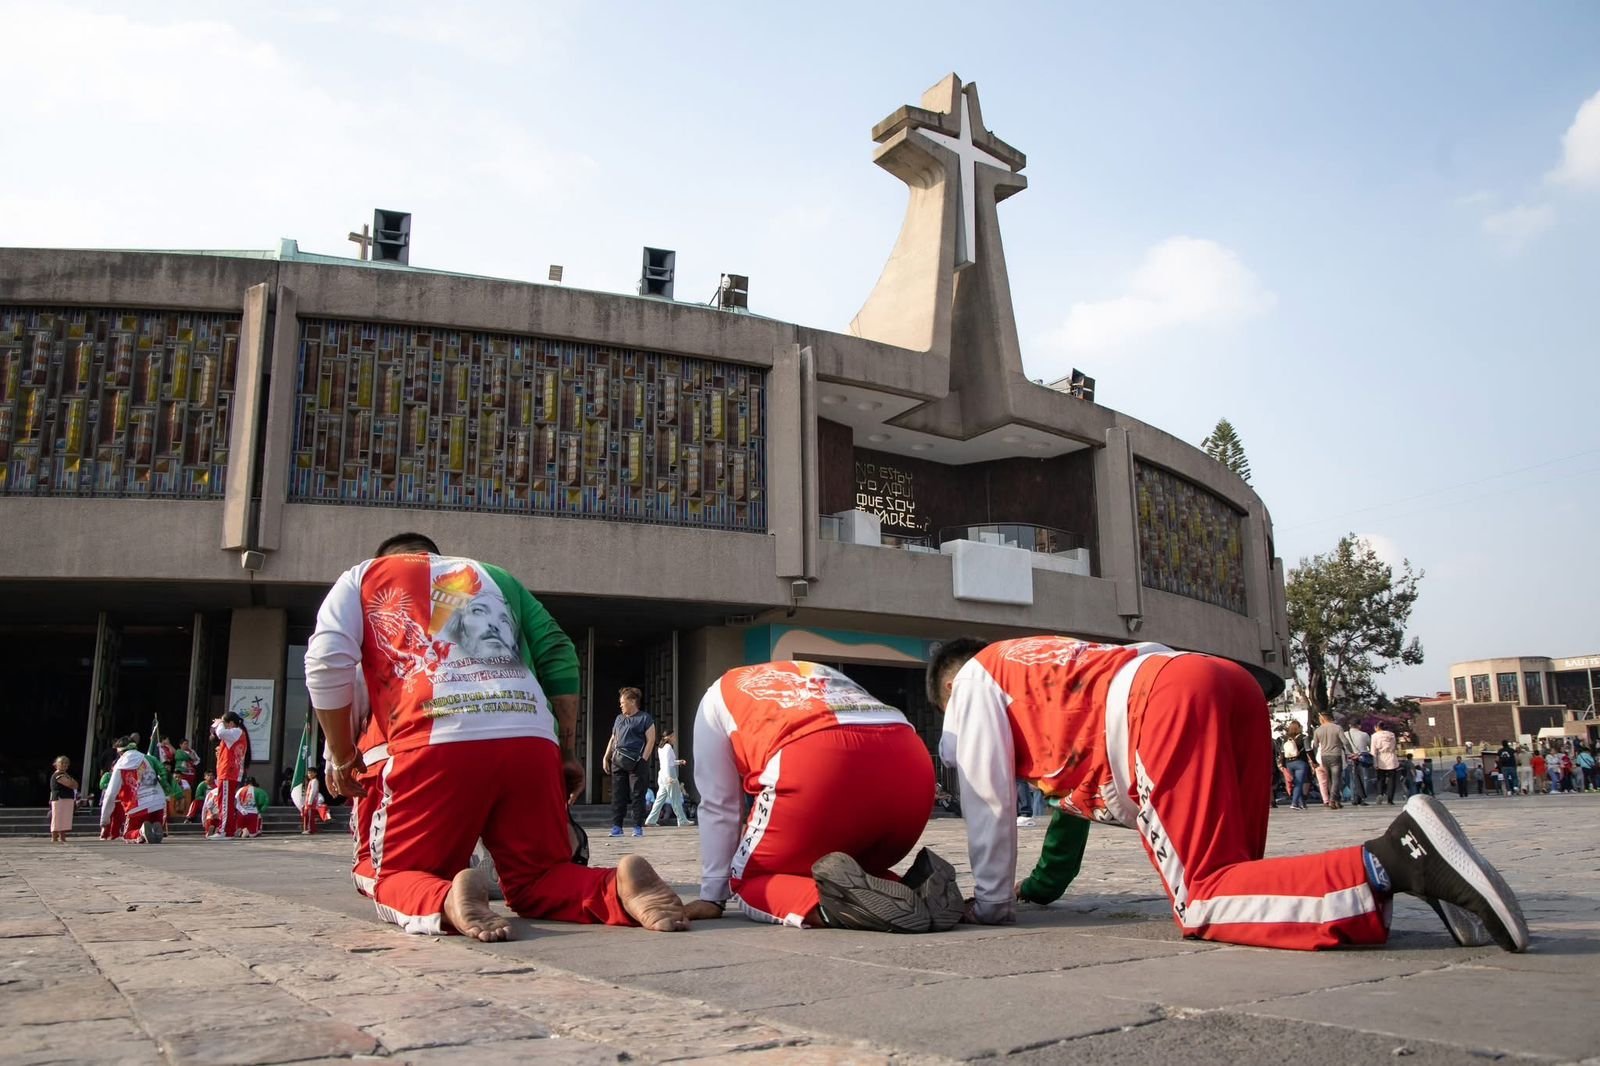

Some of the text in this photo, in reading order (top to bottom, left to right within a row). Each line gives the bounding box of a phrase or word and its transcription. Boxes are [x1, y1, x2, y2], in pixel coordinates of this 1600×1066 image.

[855, 475, 877, 490] YO
[879, 467, 912, 485] ESTOY
[856, 493, 915, 513] QUE SOY
